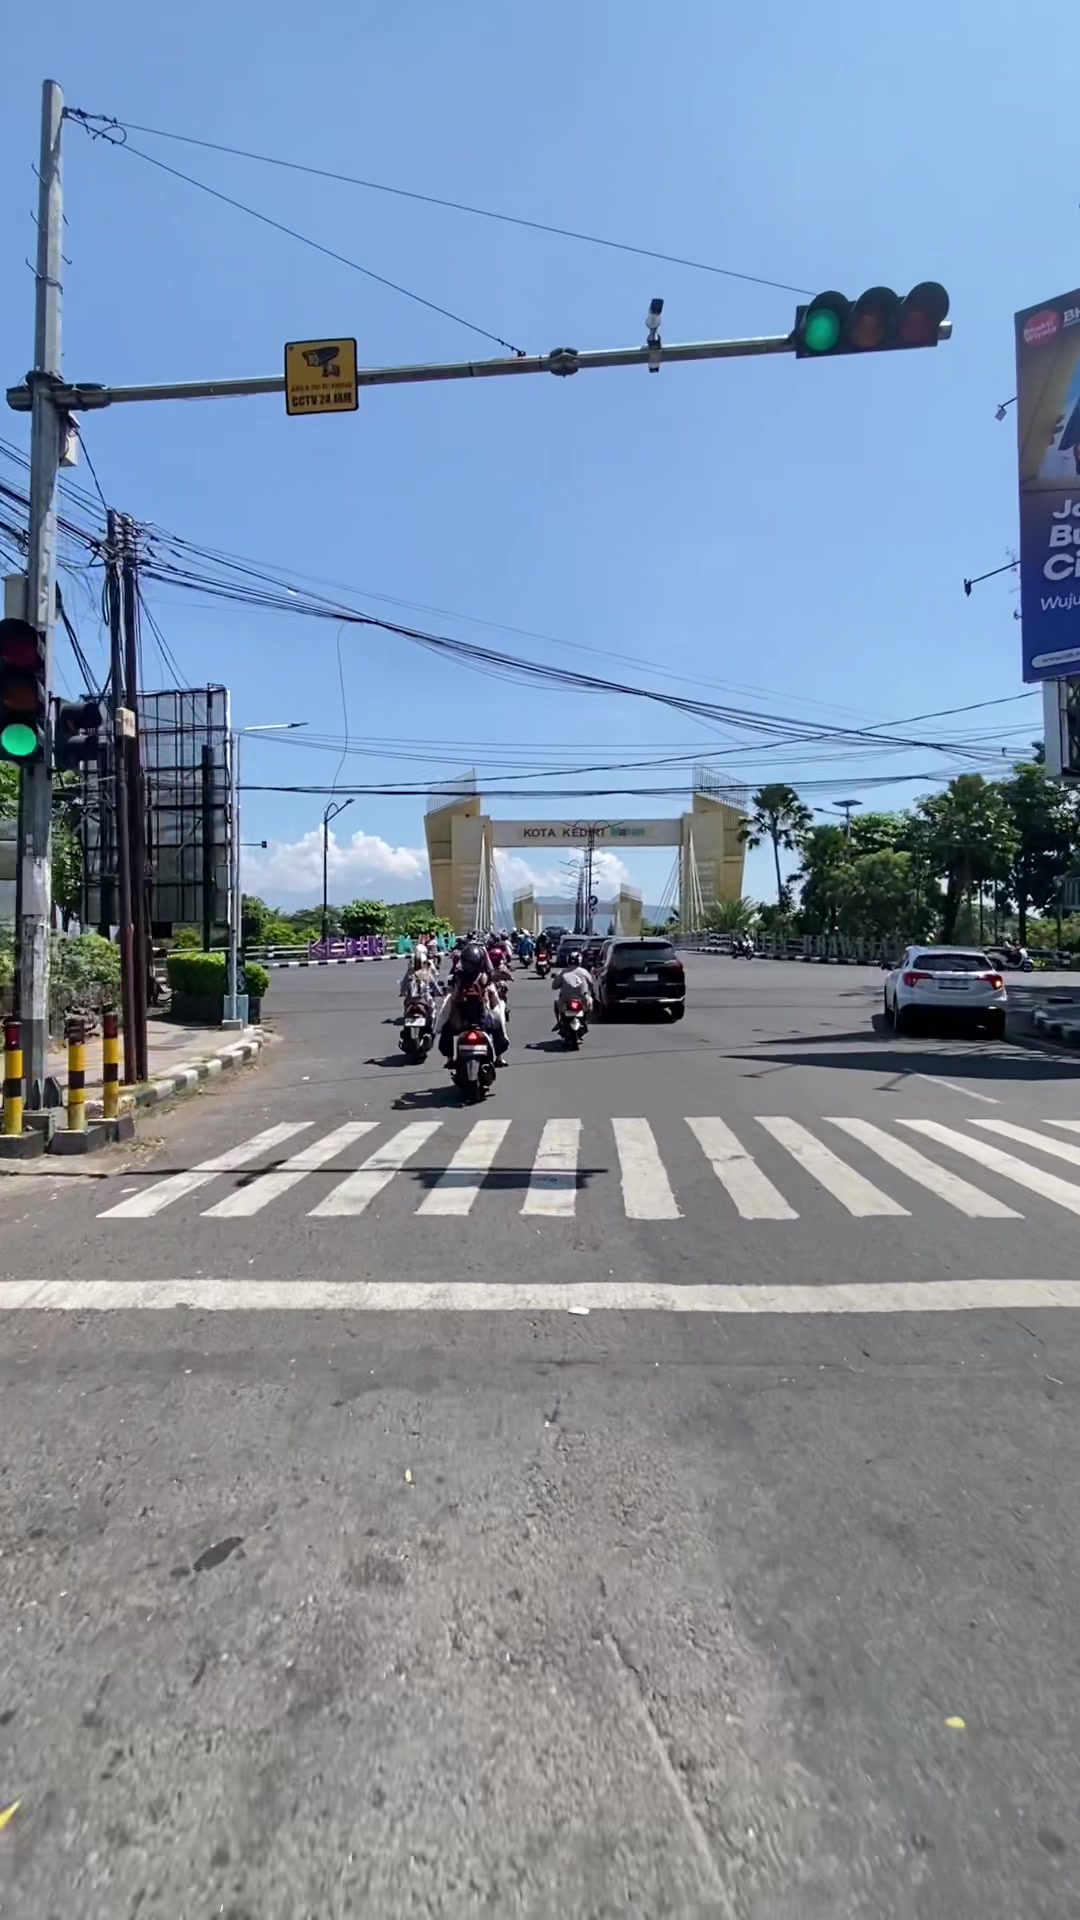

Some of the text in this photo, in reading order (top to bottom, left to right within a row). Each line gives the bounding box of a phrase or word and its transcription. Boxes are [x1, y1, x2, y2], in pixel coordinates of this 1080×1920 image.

[292, 392, 352, 407] CCTV 24 JAM
[523, 828, 556, 838] KOTA
